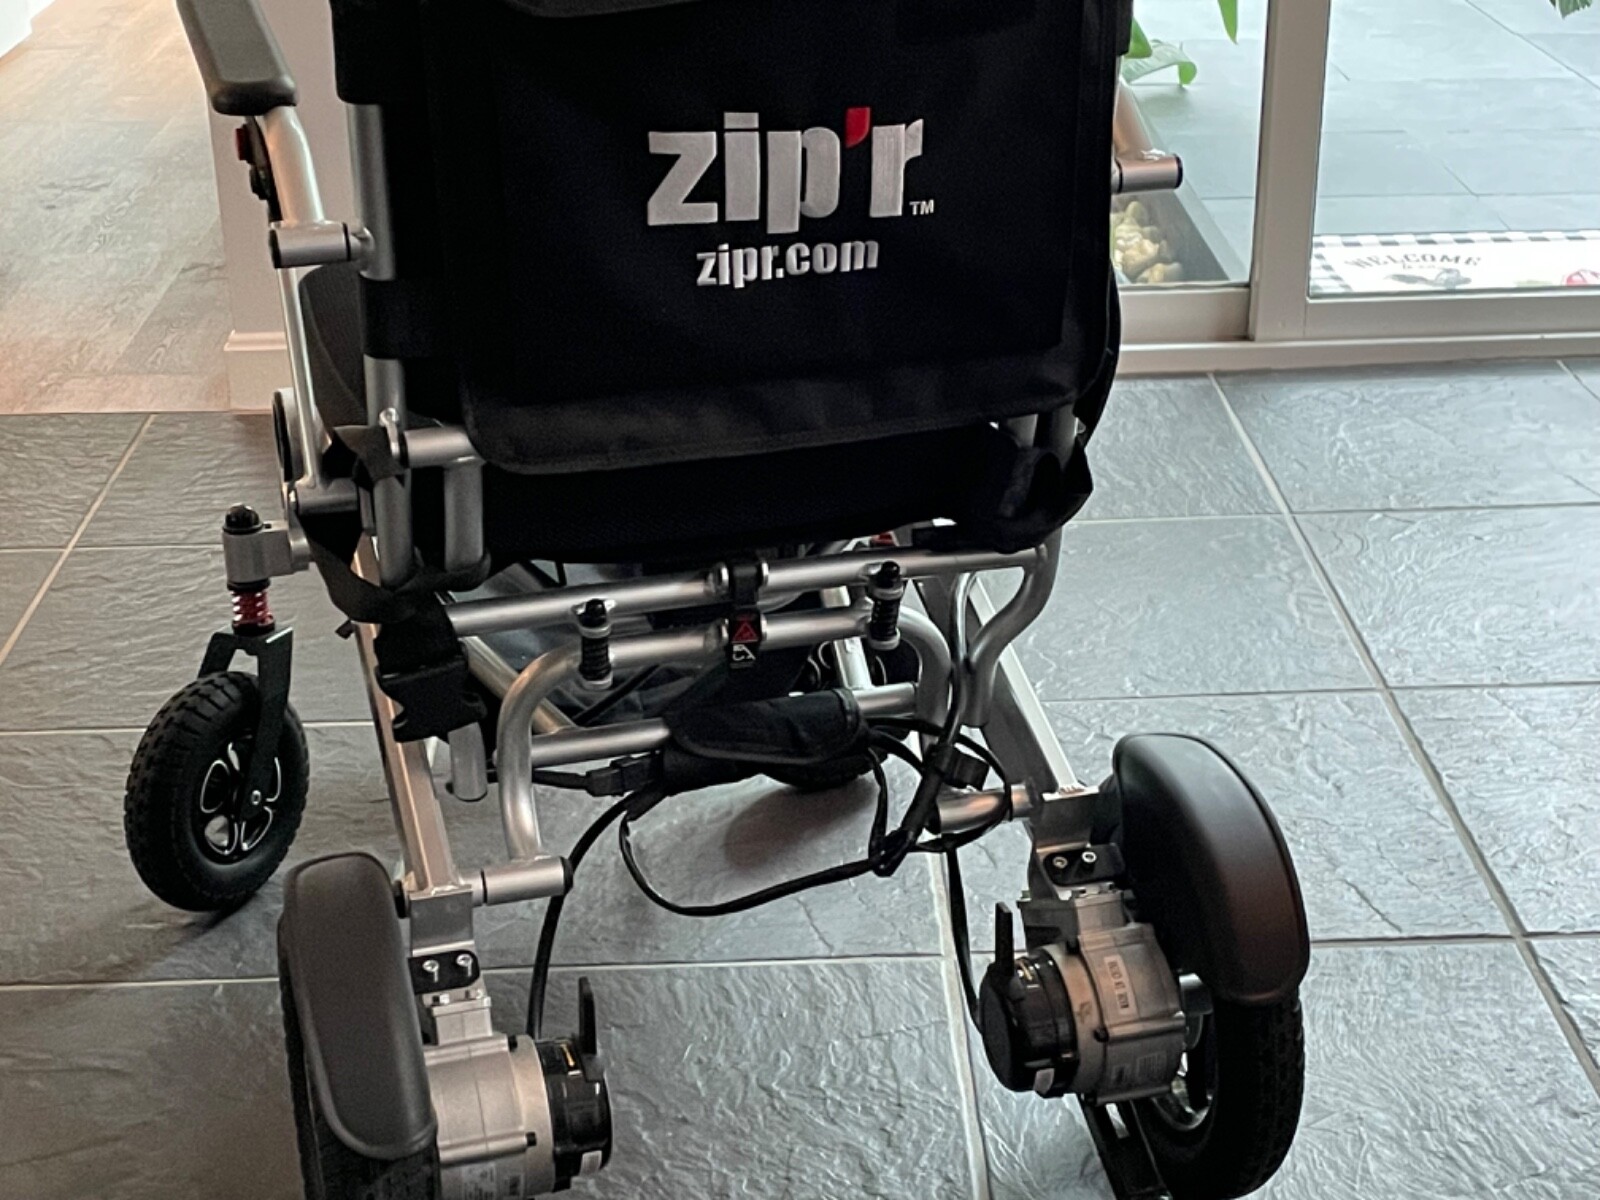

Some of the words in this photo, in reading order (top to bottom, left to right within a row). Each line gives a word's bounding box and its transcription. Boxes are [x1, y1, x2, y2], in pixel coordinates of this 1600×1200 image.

[648, 107, 924, 234] zip'r
[696, 240, 879, 288] zipr.com
[1346, 254, 1481, 268] WELCOME
